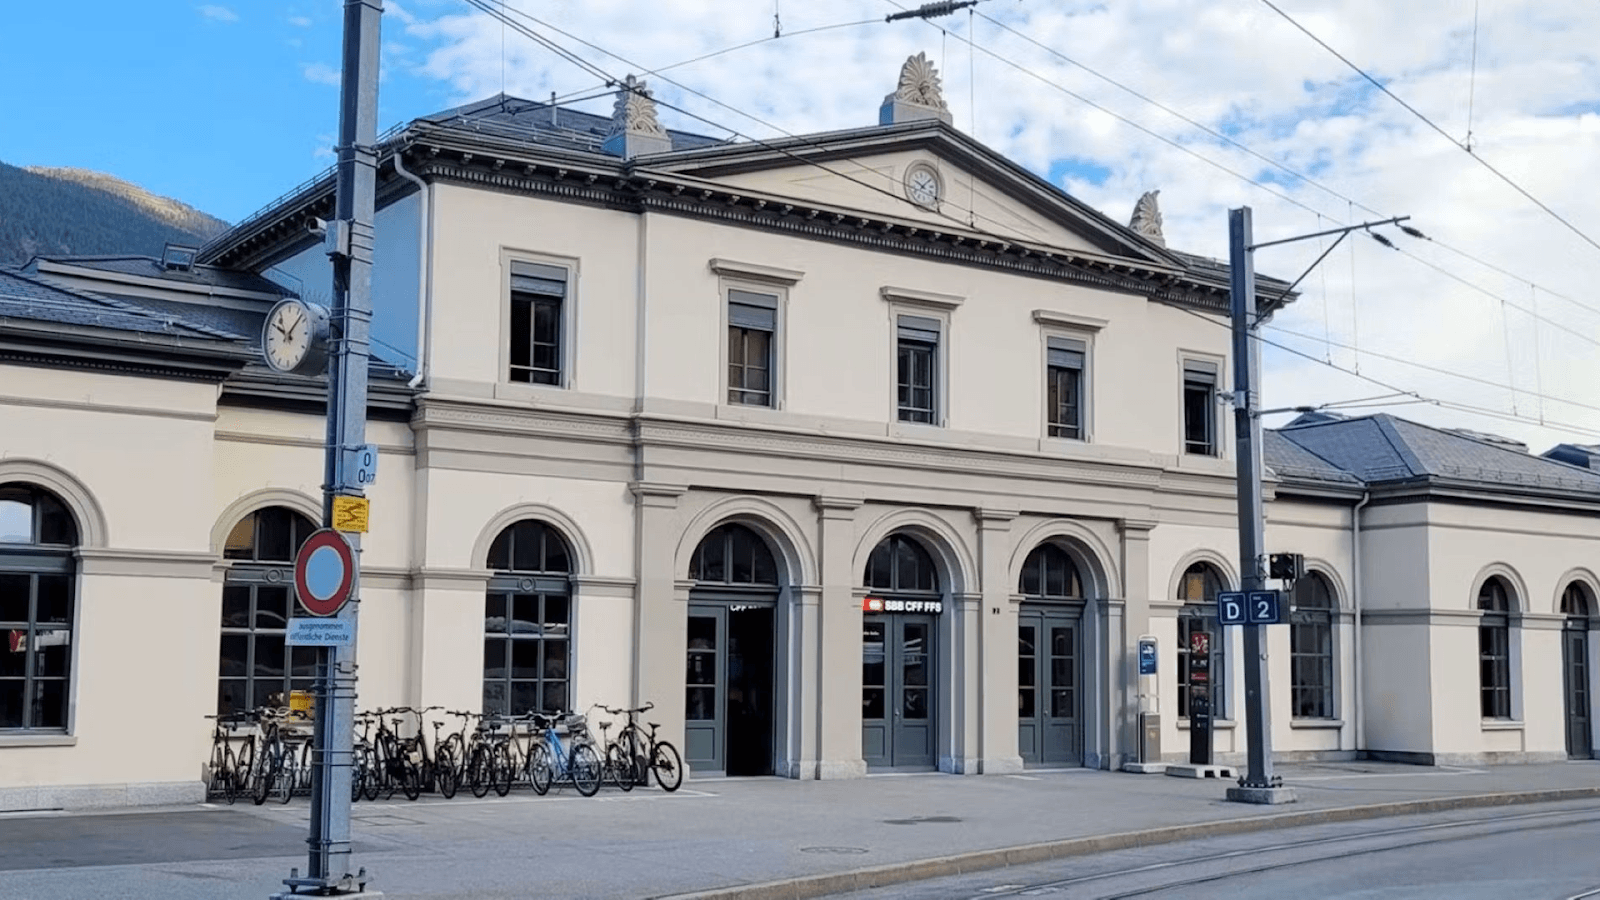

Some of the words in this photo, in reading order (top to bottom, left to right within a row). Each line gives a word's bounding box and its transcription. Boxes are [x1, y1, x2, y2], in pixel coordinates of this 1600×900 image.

[363, 452, 371, 467] 0
[885, 600, 904, 611] SBB
[905, 601, 923, 612] CFF
[924, 601, 942, 612] FFS
[1226, 602, 1239, 619] D
[1257, 601, 1269, 618] 2
